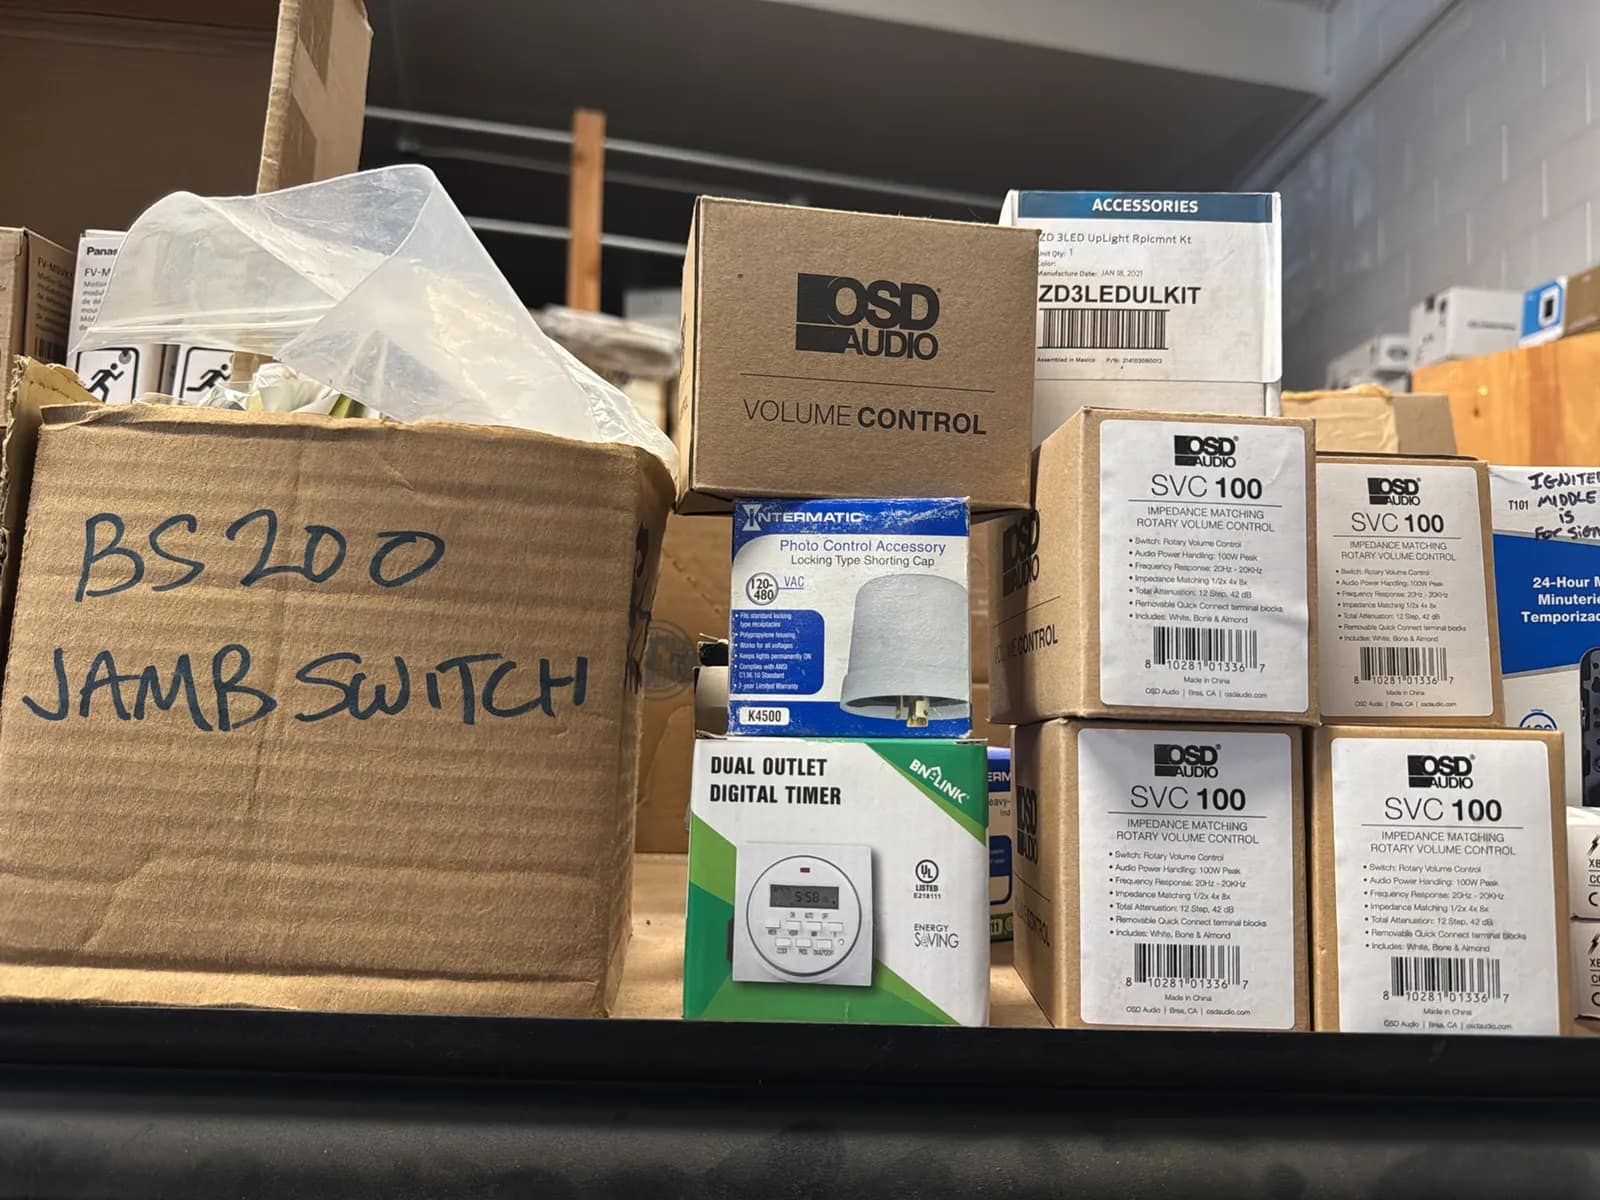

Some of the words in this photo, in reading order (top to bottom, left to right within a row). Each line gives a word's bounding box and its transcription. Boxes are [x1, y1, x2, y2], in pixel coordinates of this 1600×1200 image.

[1092, 198, 1199, 213] ACCESSORIES
[1039, 233, 1054, 242] ZD
[1058, 233, 1084, 242] 3LED
[1088, 233, 1129, 244] UpLight
[1133, 234, 1176, 246] Rplcmnt
[1180, 235, 1191, 244] Kt
[1070, 248, 1072, 256] 1
[1038, 285, 1201, 304] ZD3LEDULKIT
[826, 274, 940, 331] OSD
[844, 328, 938, 360] AUDIO
[744, 399, 851, 426] VOLUME
[858, 407, 986, 435] CONTROL
[1187, 435, 1236, 456] OSD
[1195, 456, 1236, 468] AUDIO
[1151, 474, 1207, 497] SVC
[1215, 477, 1262, 499] 100
[1379, 478, 1418, 495] OSD
[1386, 496, 1420, 506] AUDIO
[1538, 491, 1597, 507] MIDDLE
[1509, 501, 1528, 510] T101
[742, 504, 864, 531] INTERMATIC
[1148, 507, 1208, 517] IMPEDANCE
[1210, 509, 1264, 519] MATCHING
[1137, 519, 1178, 529] ROTARY
[1181, 520, 1223, 529] VOLUME
[1226, 522, 1275, 532] CONTROL
[1352, 512, 1398, 532] SVC
[1405, 514, 1444, 532] 100
[780, 540, 818, 551] Photo
[823, 541, 872, 551] Control
[876, 541, 946, 555] Accessory
[1402, 542, 1447, 550] MATCHING
[791, 555, 832, 566] Locking
[835, 556, 860, 566] Type
[864, 557, 909, 567] Shorting
[913, 557, 935, 566] Cap
[1378, 552, 1413, 560] VOLUME
[1416, 553, 1456, 561] CONTROL
[784, 576, 804, 587] VAC
[1533, 577, 1590, 588] 24-Hour
[754, 590, 774, 600] 480
[1145, 659, 1151, 669] 8
[1168, 660, 1202, 670] 10281
[1209, 661, 1246, 672] 01336
[1260, 664, 1265, 672] 7
[1354, 676, 1359, 684] 8
[1407, 677, 1437, 685] 01336
[22, 643, 277, 731] JAMB
[294, 651, 588, 725] SWITCH
[748, 710, 781, 722] K4500
[1167, 744, 1218, 766] OSD
[711, 756, 755, 775] DUAL
[763, 757, 827, 777] OUTLET
[1421, 755, 1472, 776] OSD
[1175, 766, 1218, 778] AUDIO
[1430, 777, 1473, 789] AUDIO
[710, 785, 777, 803] DIGITAL
[785, 786, 841, 805] TIMER
[1131, 785, 1188, 809] SVC
[1197, 788, 1246, 811] 100
[1385, 797, 1444, 820] SVC
[1452, 799, 1502, 822] 100
[1127, 819, 1189, 830] IMPEDANCE
[1192, 821, 1247, 831] MATCHING
[1117, 831, 1158, 841] ROTARY
[1162, 832, 1205, 842] VOLUME
[1208, 834, 1259, 844] CONTROL
[1382, 832, 1444, 841] IMPEDANCE
[1447, 832, 1504, 842] MATCHING
[1115, 851, 1141, 859] Switch:
[1144, 852, 1167, 861] Rotary
[1169, 853, 1196, 861] Volume
[1371, 844, 1413, 853] ROTARY
[1417, 845, 1461, 855] VOLUME
[1464, 846, 1516, 856] CONTROL
[921, 865, 933, 878] UL
[1115, 864, 1136, 872] Audio
[1116, 877, 1153, 886] Frequency
[1116, 890, 1155, 899] Impedance
[1158, 892, 1191, 900] Matching
[914, 923, 949, 932] ENERGY
[1116, 916, 1156, 924] Removable
[1158, 917, 1179, 925] Quick
[1181, 918, 1211, 926] Connect
[1213, 919, 1241, 927] terminal
[1243, 919, 1267, 927] blocks
[1126, 977, 1132, 986] 8
[1148, 978, 1184, 988] 10281
[1191, 979, 1228, 989] 01336
[1243, 980, 1248, 989] 7
[1383, 991, 1389, 1000] 8
[1406, 992, 1442, 1001] 10281
[1450, 992, 1488, 1003] 01336
[1503, 994, 1509, 1003] 7
